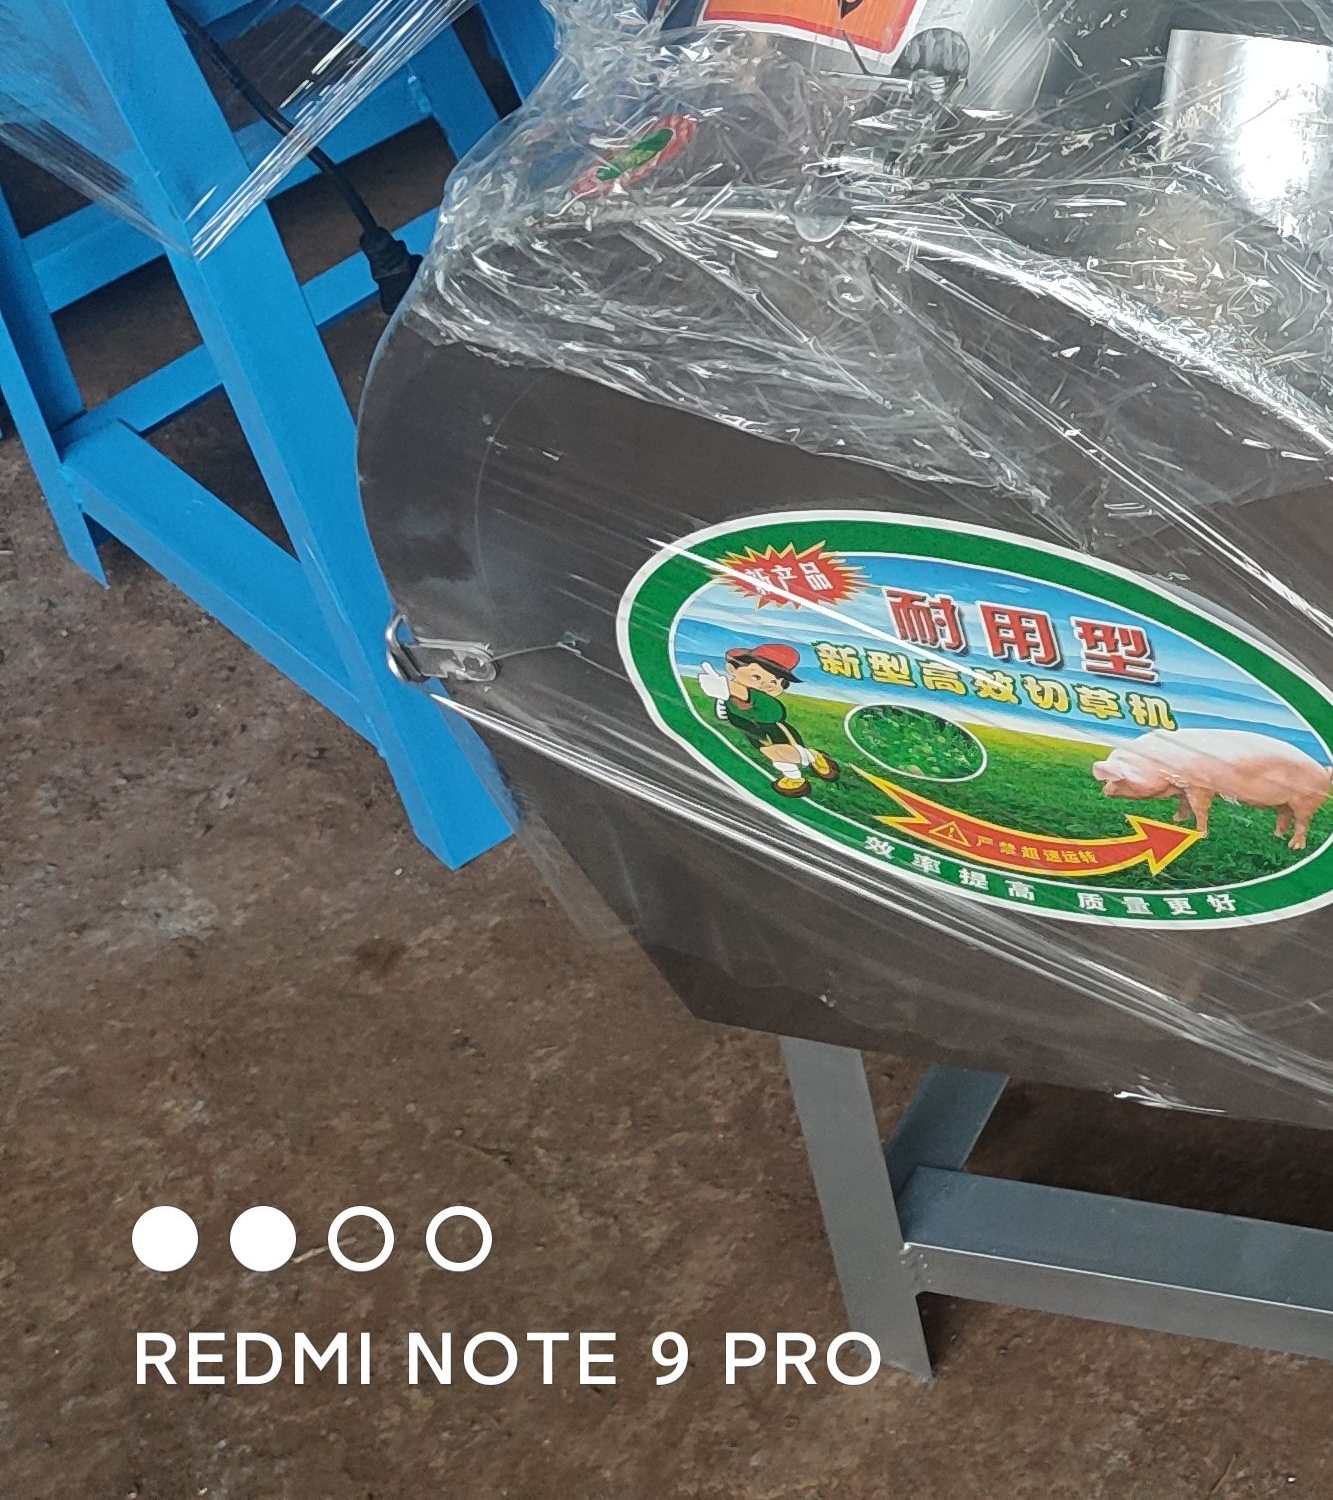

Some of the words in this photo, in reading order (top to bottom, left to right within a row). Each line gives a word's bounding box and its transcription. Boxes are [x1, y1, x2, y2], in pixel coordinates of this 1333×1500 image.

[745, 560, 834, 596] 新产品
[883, 586, 1161, 685] 耐用型
[812, 641, 1178, 731] 新型高效切草机
[864, 835, 1035, 901] 效率提高
[1078, 891, 1237, 916] 质量更好
